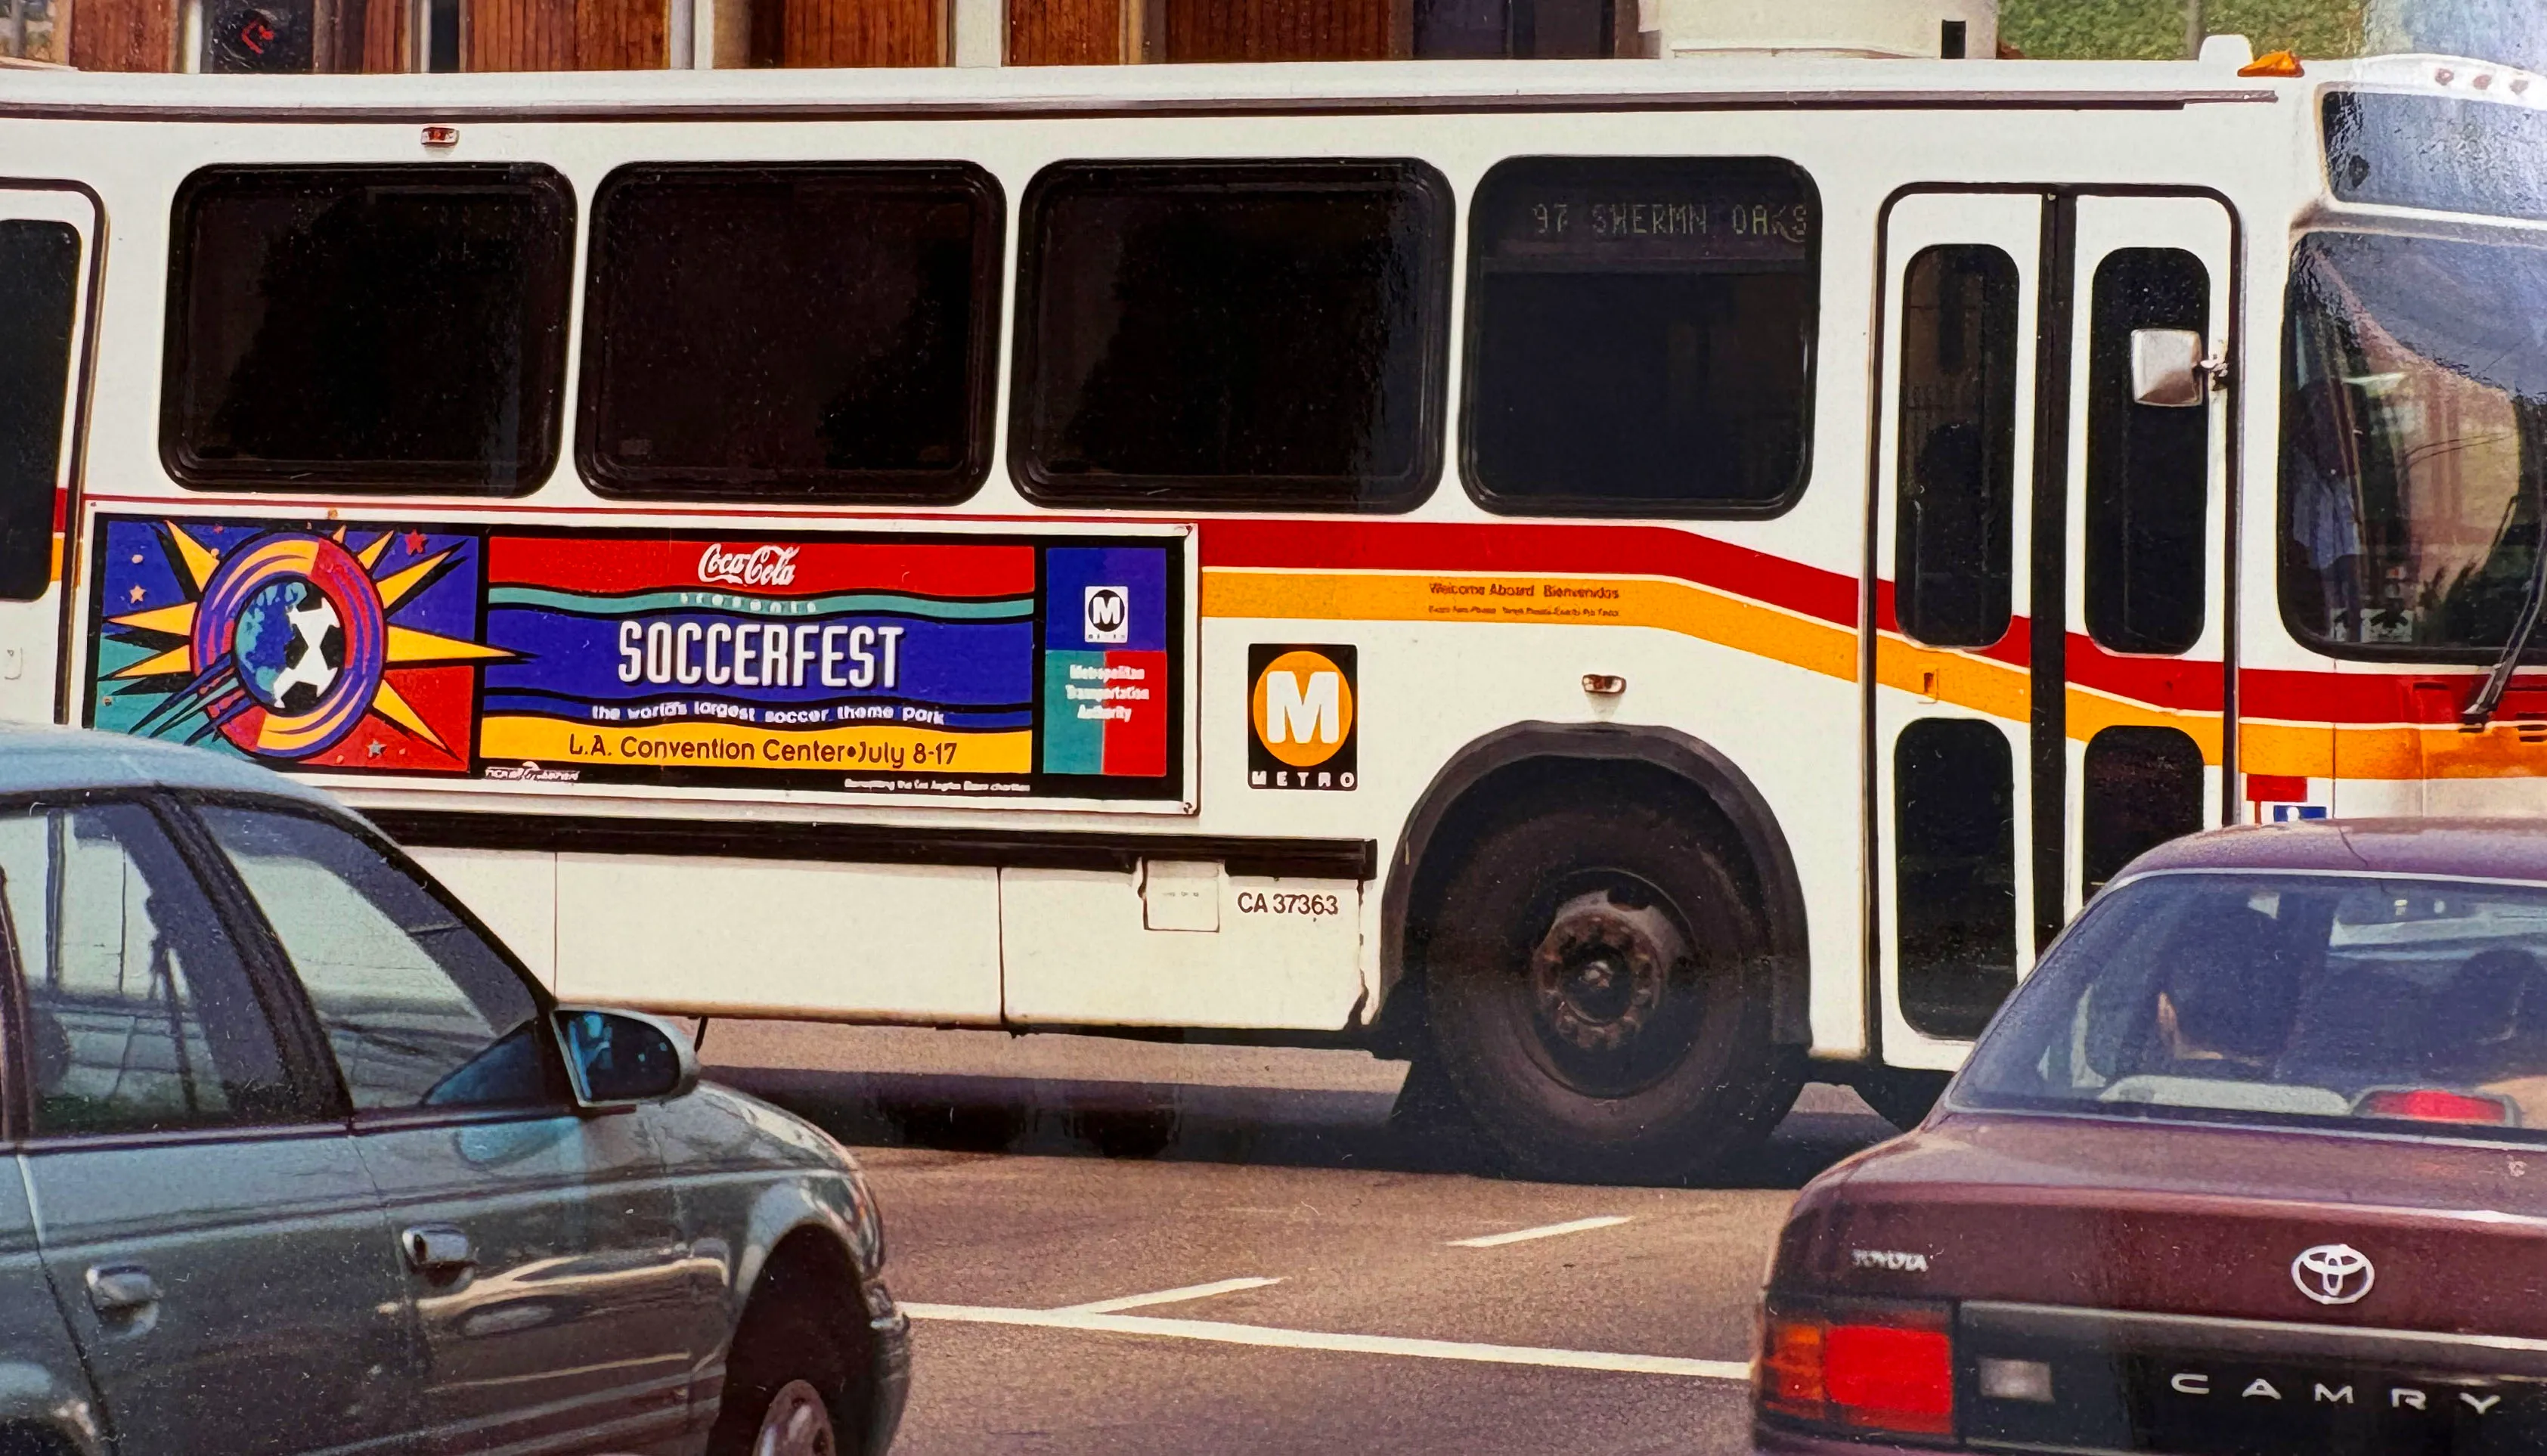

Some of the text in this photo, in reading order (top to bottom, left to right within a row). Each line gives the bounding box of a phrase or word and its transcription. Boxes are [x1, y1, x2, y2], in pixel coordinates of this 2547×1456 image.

[1532, 202, 1568, 234] 97
[1731, 202, 1808, 239] OAKS
[698, 543, 801, 587] Coca-Cola
[1429, 583, 1486, 596] Welcome
[1489, 584, 1535, 596] Aboard
[1092, 596, 1120, 624] M
[618, 620, 905, 688] SOCCERFEST
[592, 705, 621, 720] the
[694, 702, 755, 721] largest
[765, 708, 829, 723] soccer
[837, 705, 894, 719] theme
[1266, 671, 1340, 744] M
[569, 733, 612, 757] L.A.
[621, 736, 755, 761] Convention
[913, 742, 958, 765] 8-17
[1251, 770, 1356, 788] METRO
[1237, 891, 1339, 915] CA 37363
[1851, 1249, 1929, 1272] TOYOTA
[2171, 1373, 2501, 1414] CAMRY
